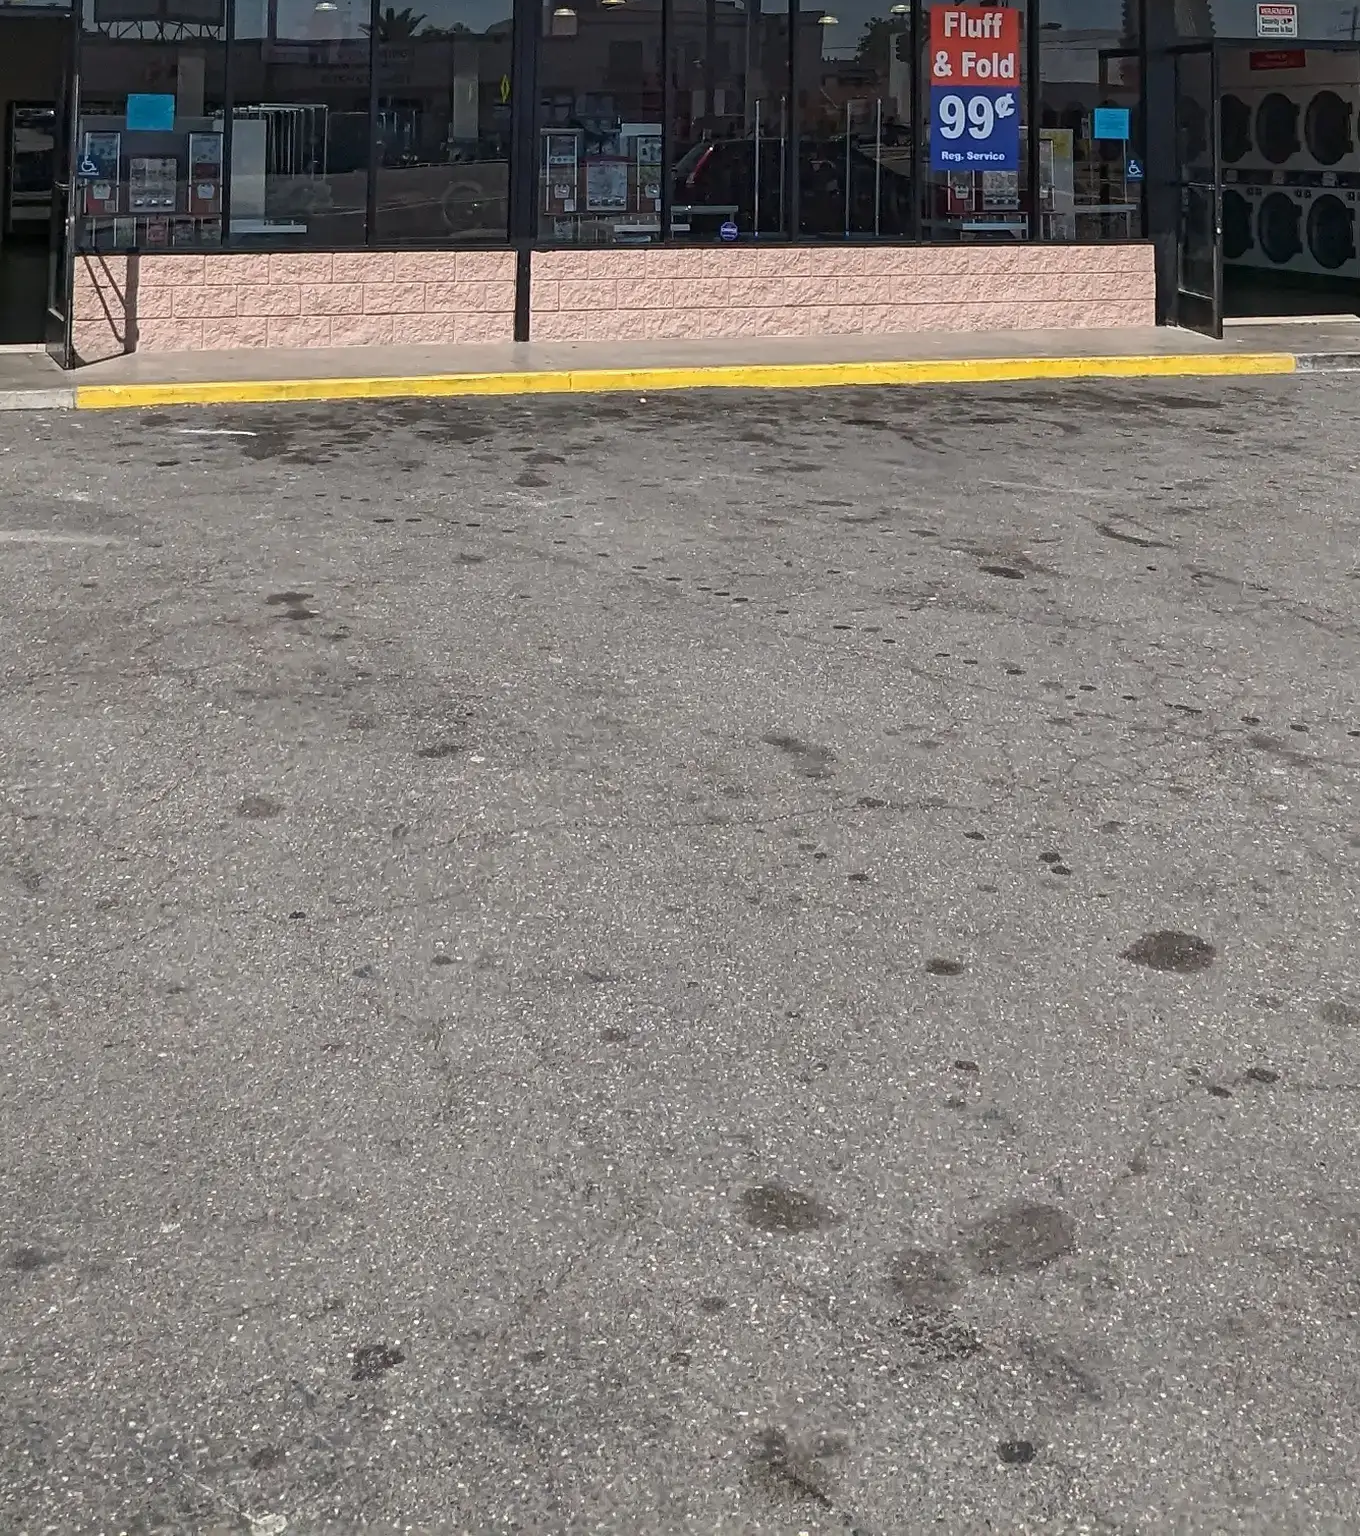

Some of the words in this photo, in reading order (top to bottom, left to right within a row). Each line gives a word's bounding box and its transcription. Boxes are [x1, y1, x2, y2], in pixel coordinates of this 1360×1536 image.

[944, 11, 1003, 39] Fluff
[933, 50, 952, 77] &
[961, 51, 1015, 78] Fold
[939, 93, 1015, 140] 99¢
[941, 151, 964, 161] Reg.
[967, 151, 1005, 161] Service
